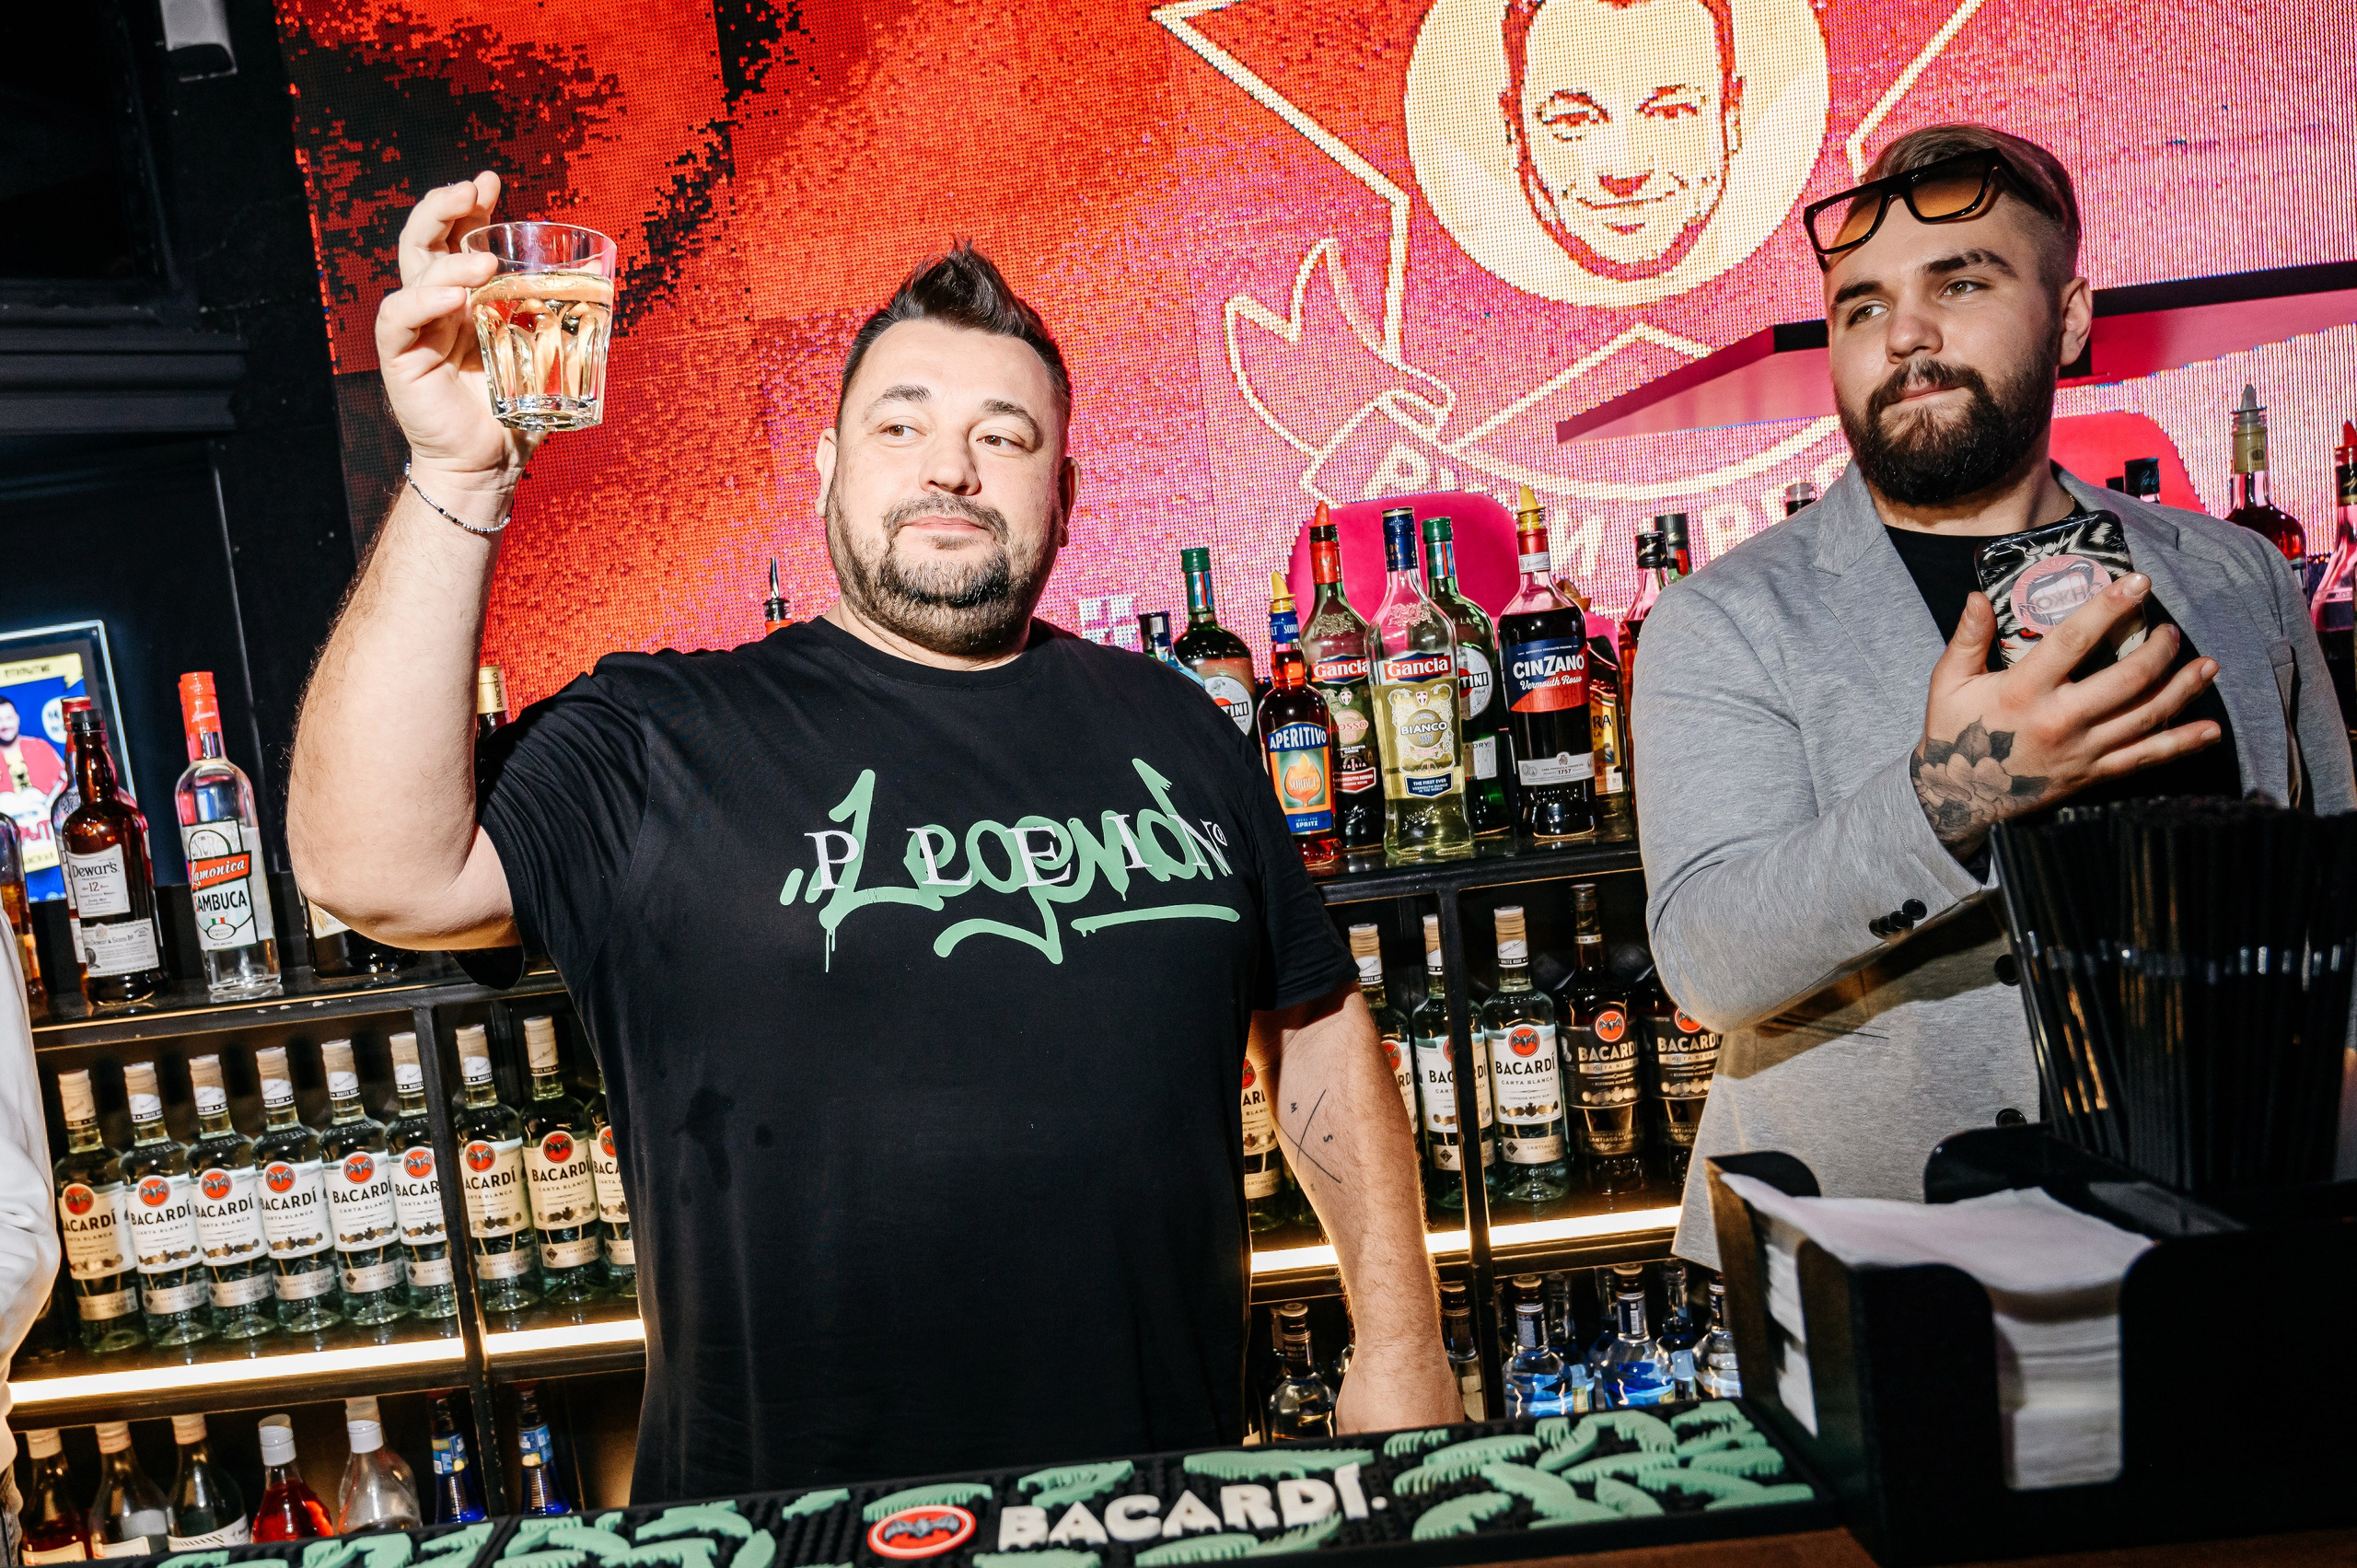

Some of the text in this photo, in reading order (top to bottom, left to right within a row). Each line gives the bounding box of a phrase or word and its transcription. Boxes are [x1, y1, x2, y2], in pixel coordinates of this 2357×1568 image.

[1313, 659, 1369, 678] Gancia
[1387, 657, 1449, 677] Gancia
[1513, 655, 1585, 679] CINZANO
[1459, 672, 1487, 688] TINI
[1520, 675, 1583, 691] Vermouth Rosso
[1221, 703, 1248, 717] TINI
[1270, 726, 1327, 750] APERITIVO
[1400, 721, 1447, 735] BIANCO
[1289, 777, 1317, 790] SORBET
[1295, 820, 1318, 829] SPRITZ
[804, 813, 1234, 892] PLEIN
[73, 862, 118, 877] Dewar's
[191, 859, 246, 890] Lamonica
[88, 881, 100, 892] 12
[193, 890, 248, 912] SAMBUCA
[1495, 1052, 1556, 1075] BACARDÍ
[465, 1165, 517, 1191] ACARDÍ
[532, 1155, 592, 1183] BACARDÍ
[260, 1186, 319, 1212] BACARDÍ
[332, 1175, 393, 1204] BACARDÍ
[395, 1180, 441, 1197] BACAR
[132, 1199, 192, 1226] BACARDÍ
[194, 1192, 254, 1219] BACARDÍ
[64, 1208, 117, 1233] ACARDÍ
